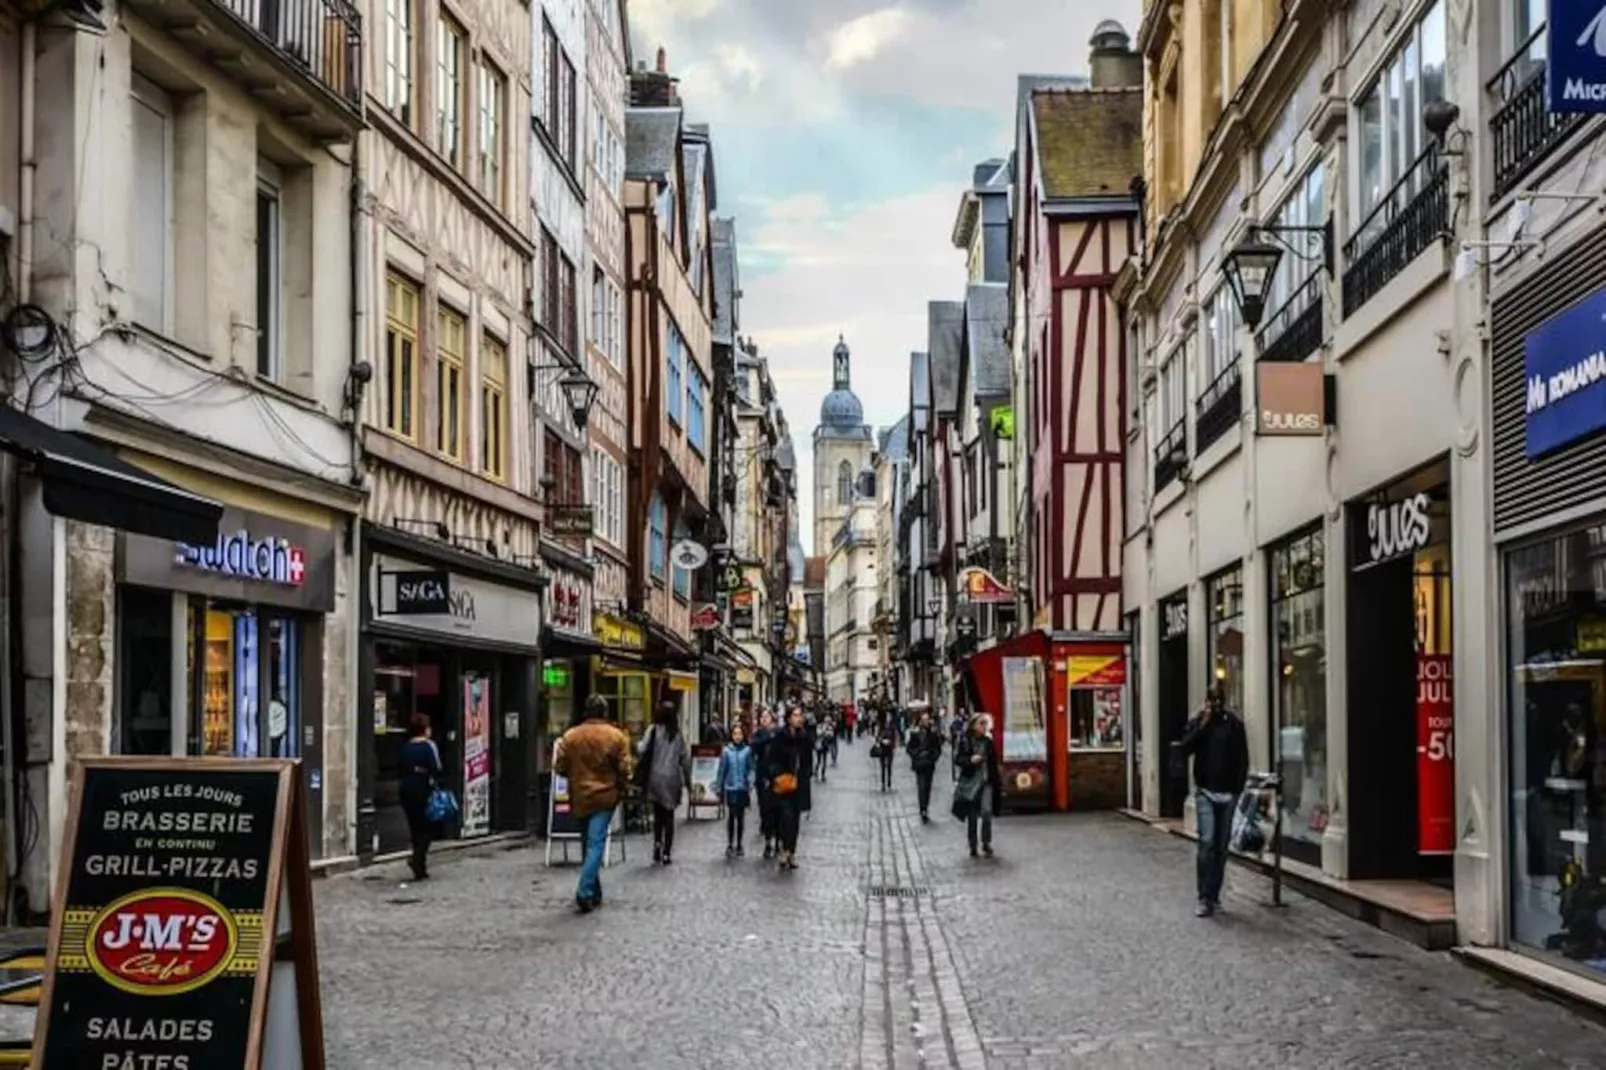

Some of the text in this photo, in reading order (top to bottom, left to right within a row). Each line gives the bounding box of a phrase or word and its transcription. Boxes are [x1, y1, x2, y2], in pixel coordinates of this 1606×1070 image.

[120, 784, 243, 807] TOUS LES JOURS
[103, 810, 254, 833] BRASSERIE
[135, 837, 217, 850] EN CONTINU
[120, 952, 194, 980] Café
[86, 1017, 214, 1041] SALADES
[102, 1050, 190, 1070] PÂTES
